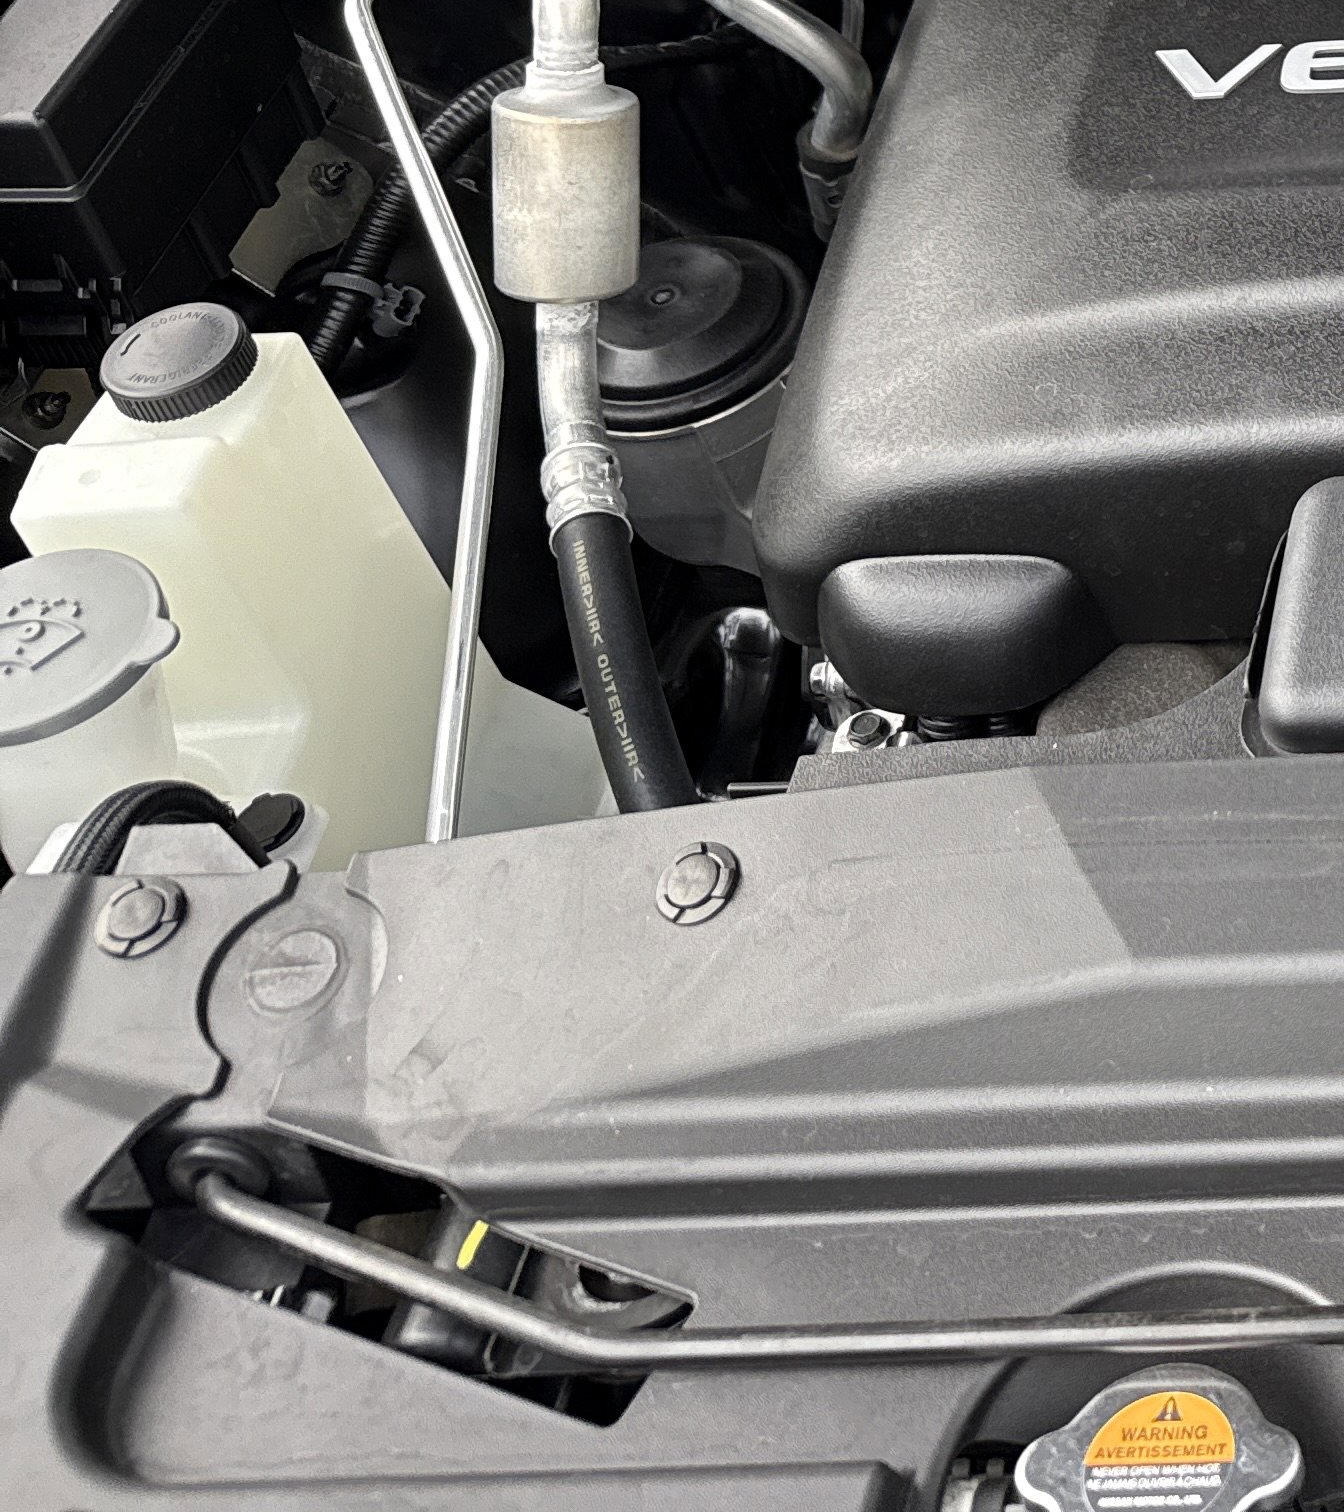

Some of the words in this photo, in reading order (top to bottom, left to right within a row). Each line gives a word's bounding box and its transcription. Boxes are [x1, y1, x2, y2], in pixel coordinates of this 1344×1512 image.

[150, 311, 208, 329] COOLANT
[1121, 1424, 1208, 1441] WARNING
[1094, 1443, 1228, 1460] AVERTISSEMENT
